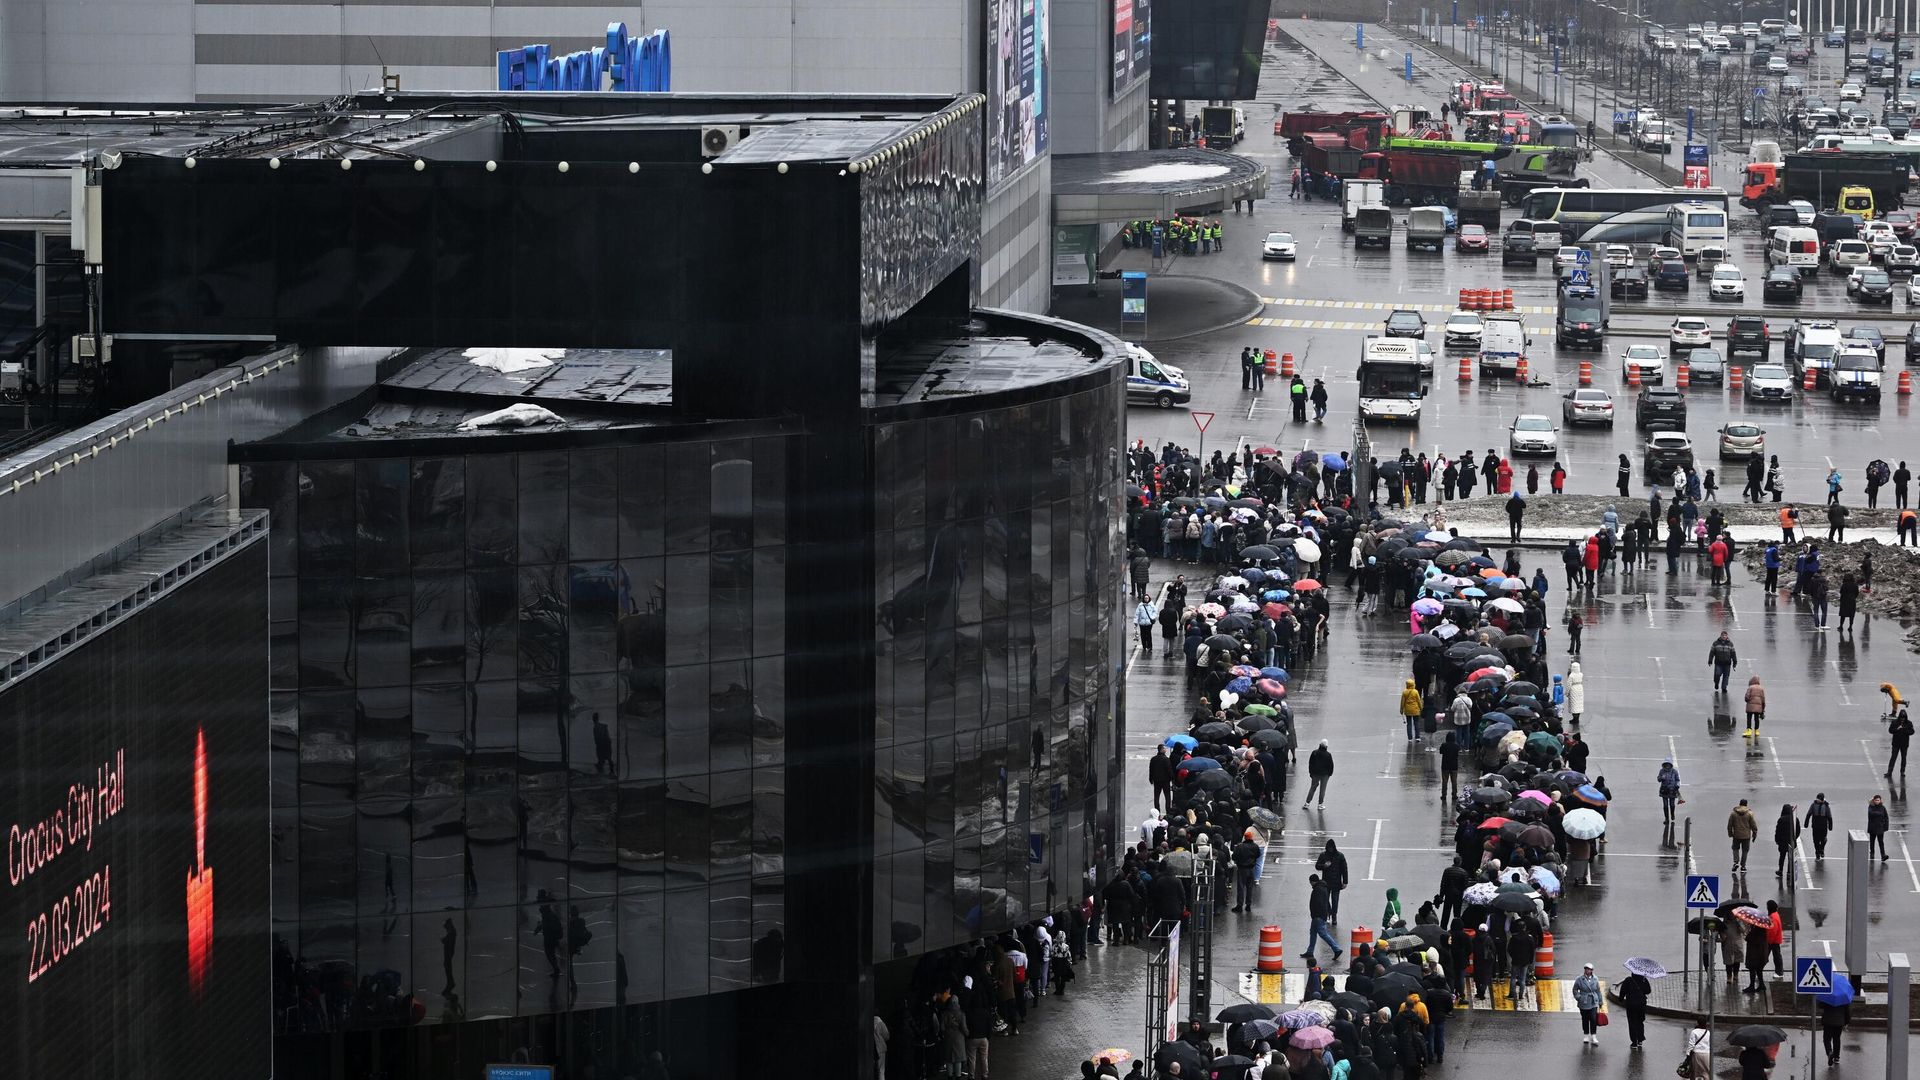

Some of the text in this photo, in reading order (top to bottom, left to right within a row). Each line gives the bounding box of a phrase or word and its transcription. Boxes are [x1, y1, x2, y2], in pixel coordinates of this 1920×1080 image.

[9, 748, 124, 886] Crocus City Hall
[28, 865, 110, 983] 22.03.2024
